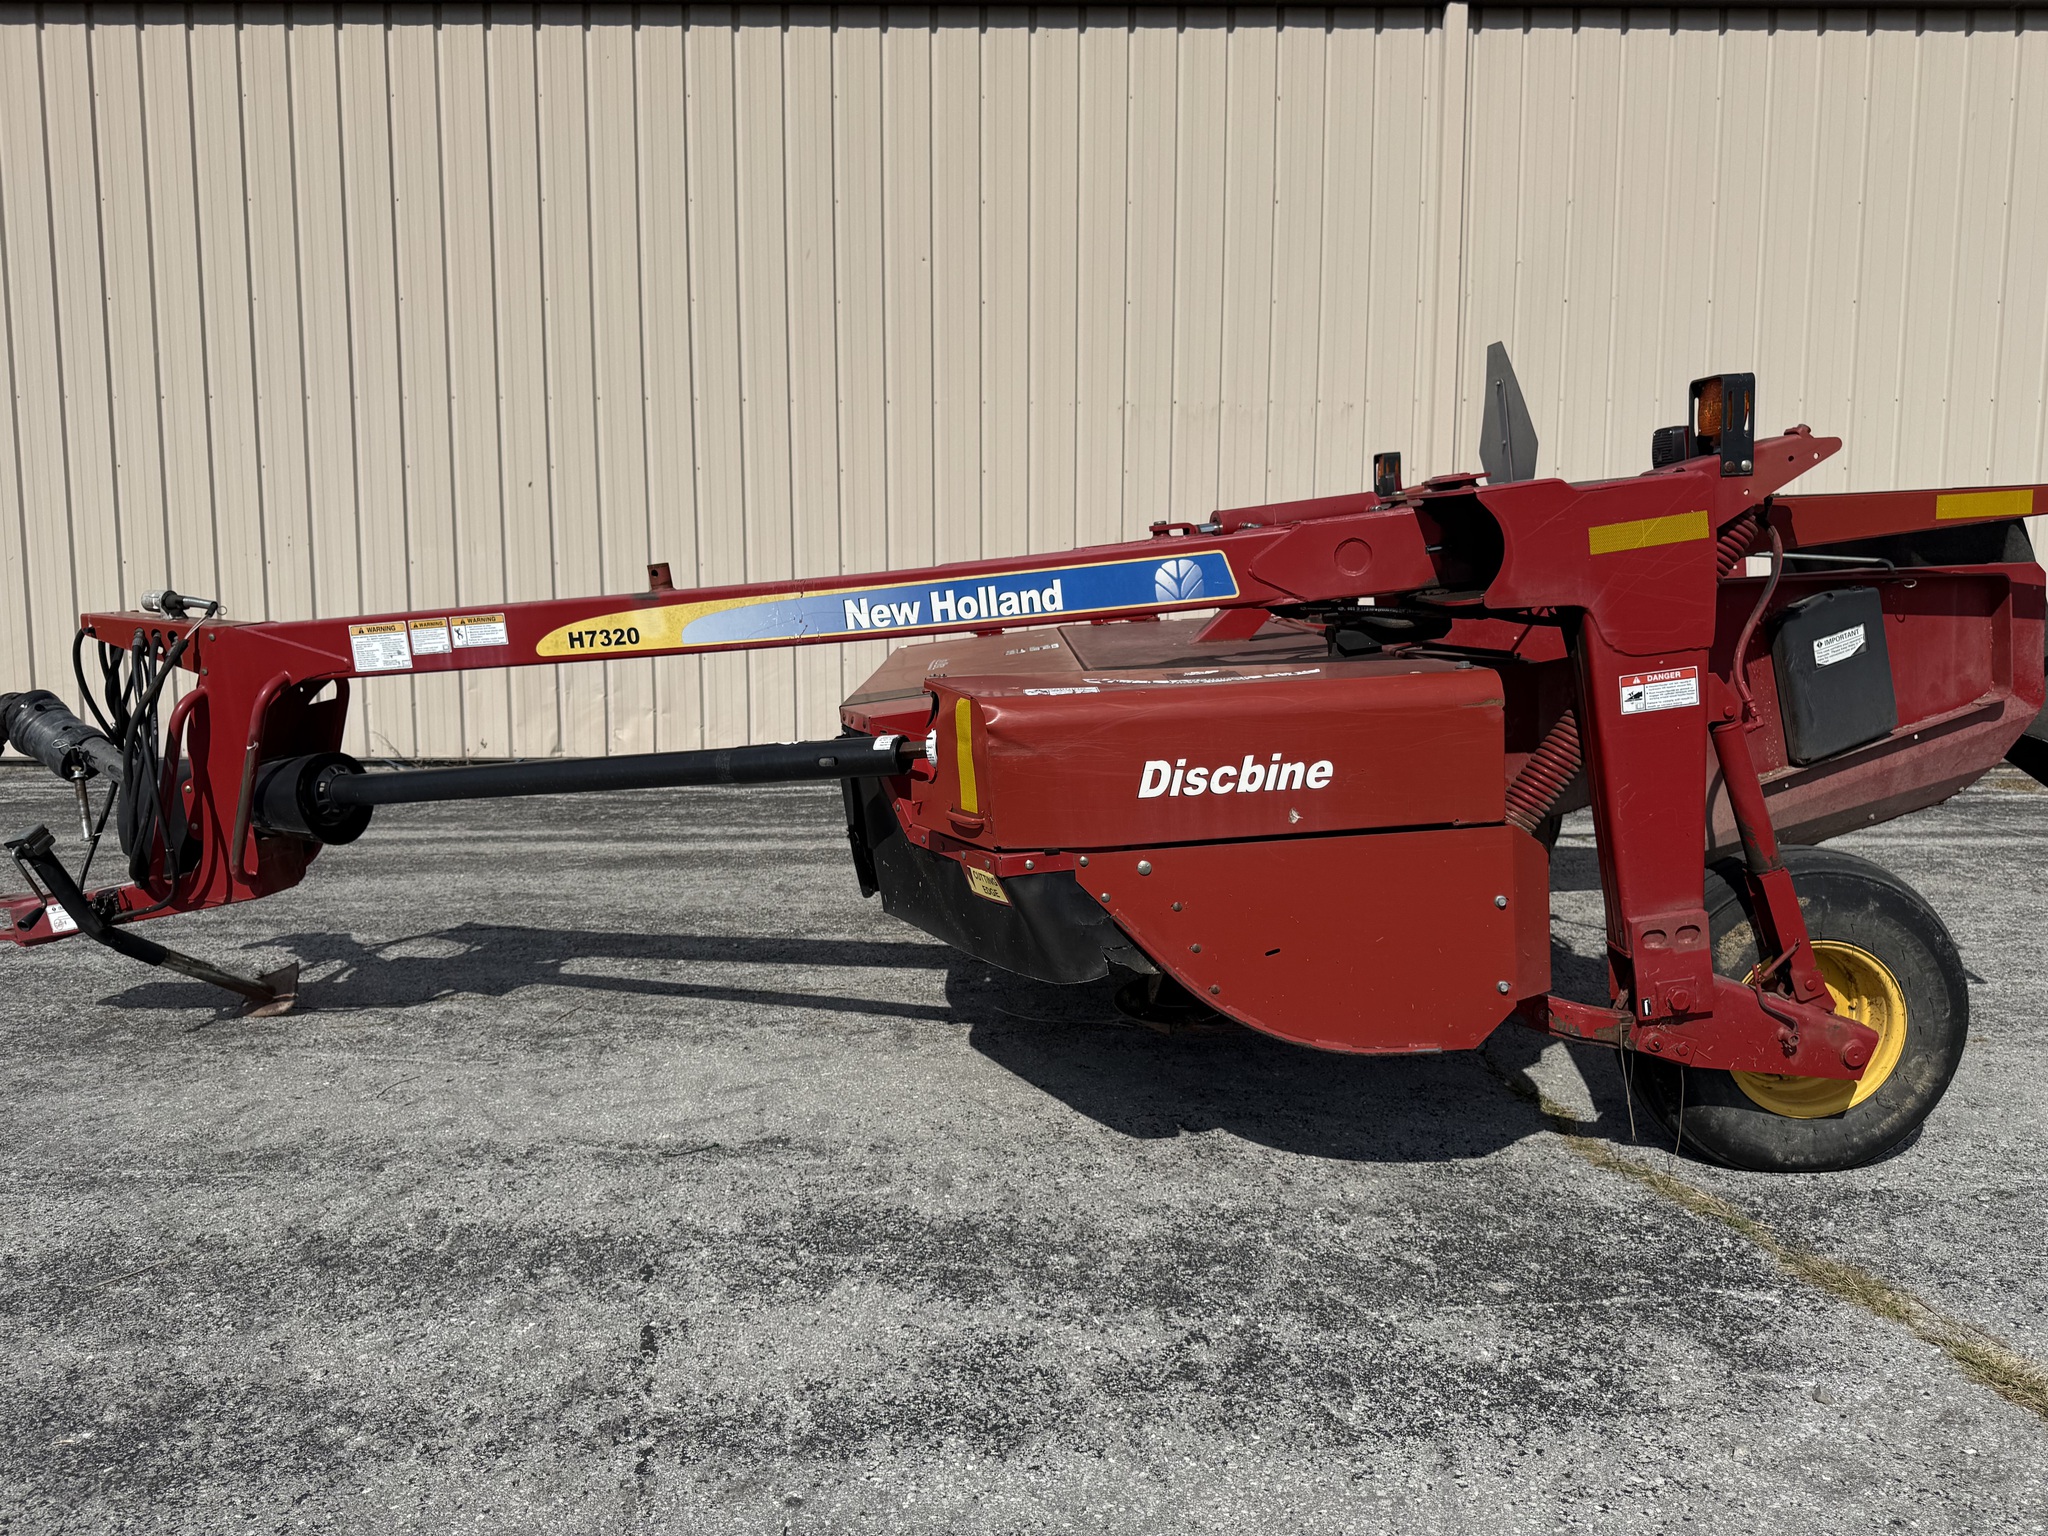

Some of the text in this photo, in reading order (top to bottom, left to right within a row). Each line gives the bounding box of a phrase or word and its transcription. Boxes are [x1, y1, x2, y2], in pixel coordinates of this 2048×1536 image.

[843, 578, 1064, 630] New Holland
[419, 620, 443, 628] WARNING
[467, 616, 496, 624] WARNING
[366, 624, 396, 633] WARNING
[567, 627, 640, 649] H7320
[1824, 628, 1859, 647] IMPORTANT
[1646, 671, 1681, 682] DANGER
[1137, 752, 1334, 799] Discbine
[972, 870, 998, 887] CUTTING
[982, 885, 1001, 898] EDGE
